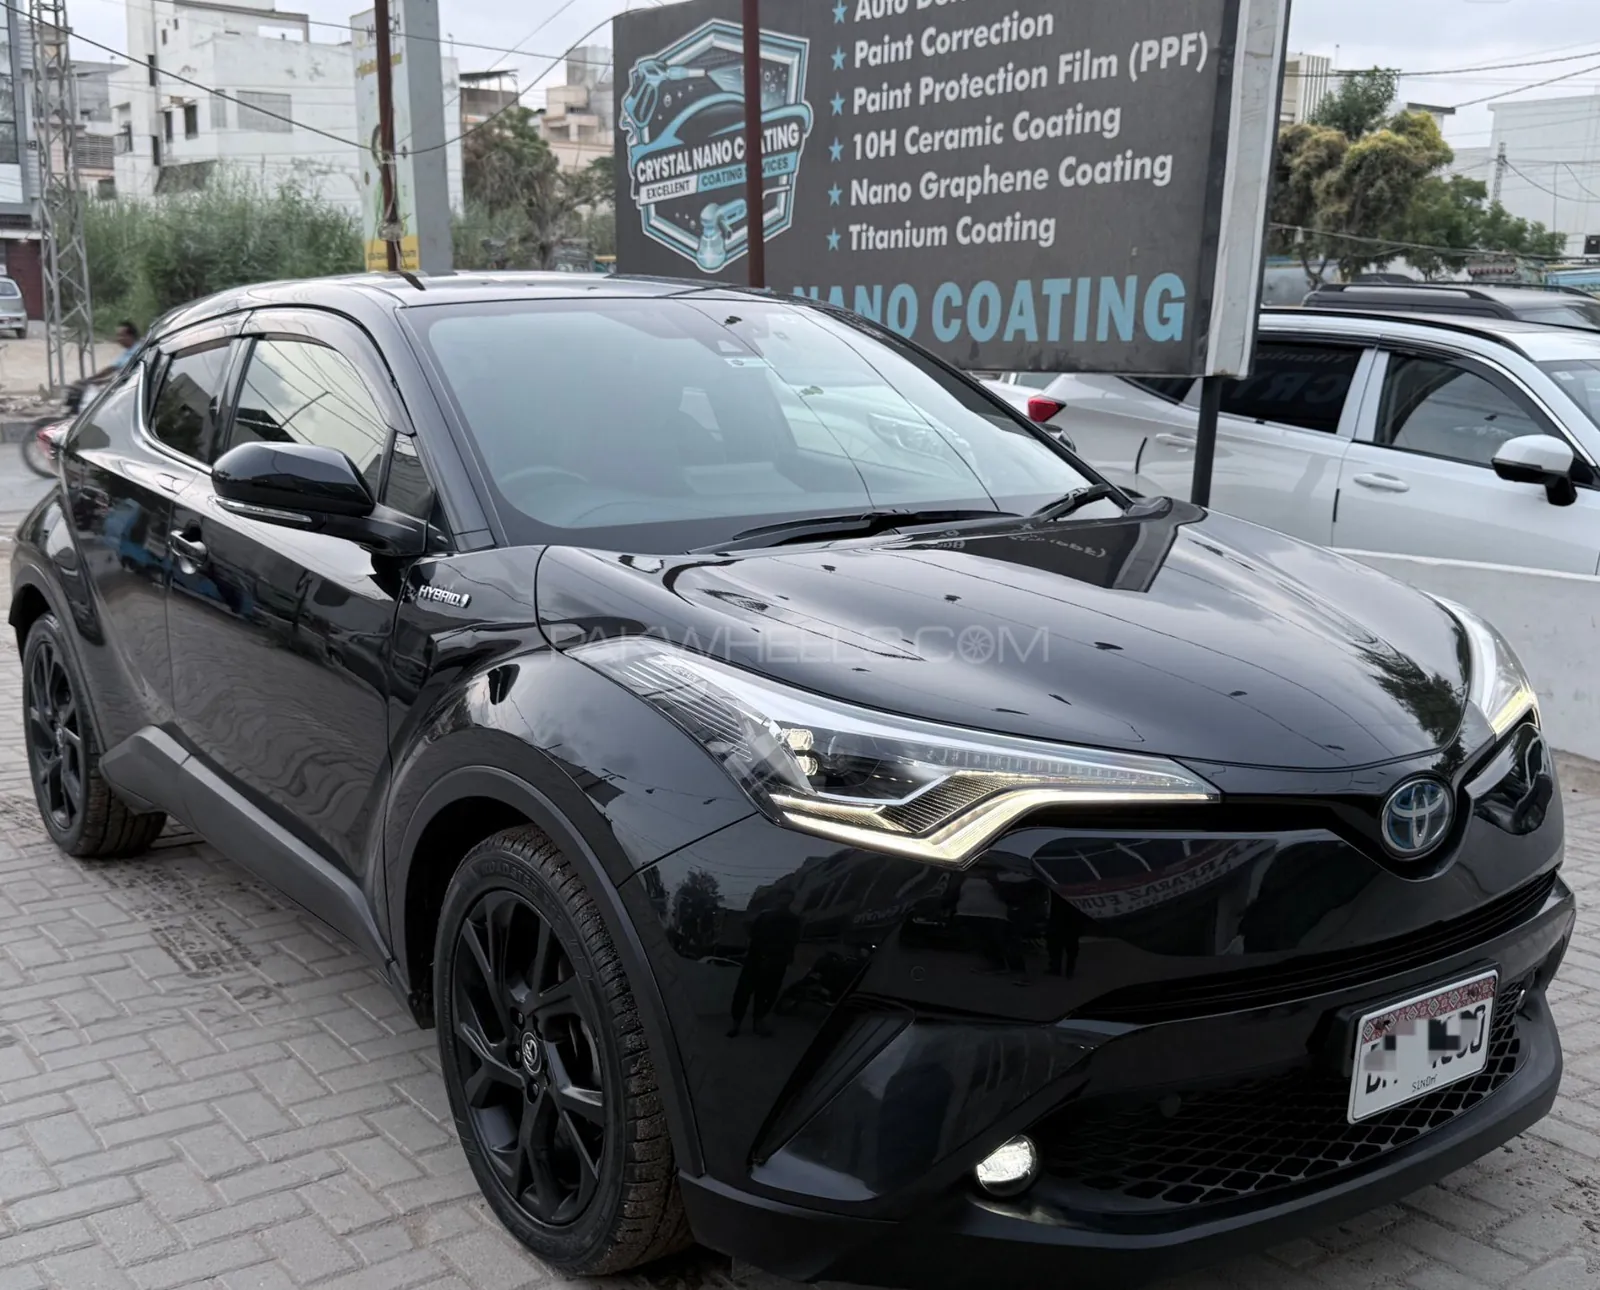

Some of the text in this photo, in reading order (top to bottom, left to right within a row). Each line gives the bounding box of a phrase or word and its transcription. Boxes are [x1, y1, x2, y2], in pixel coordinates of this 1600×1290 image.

[854, 0, 908, 22] Auto
[854, 10, 1054, 69] Paint Correction
[853, 30, 1208, 115] Paint Protection Film (PPF)
[636, 122, 800, 183] CRYSTAL NANO CTING
[853, 102, 1121, 161] 10H Ceramic Coating
[646, 180, 691, 200] EXCELLENT
[701, 169, 743, 187] COATING
[851, 149, 1173, 206] Nano Graphene Coating
[849, 211, 1056, 251] Titanium Coating
[793, 272, 1187, 343] NO COATING
[419, 584, 461, 606] HYBRID
